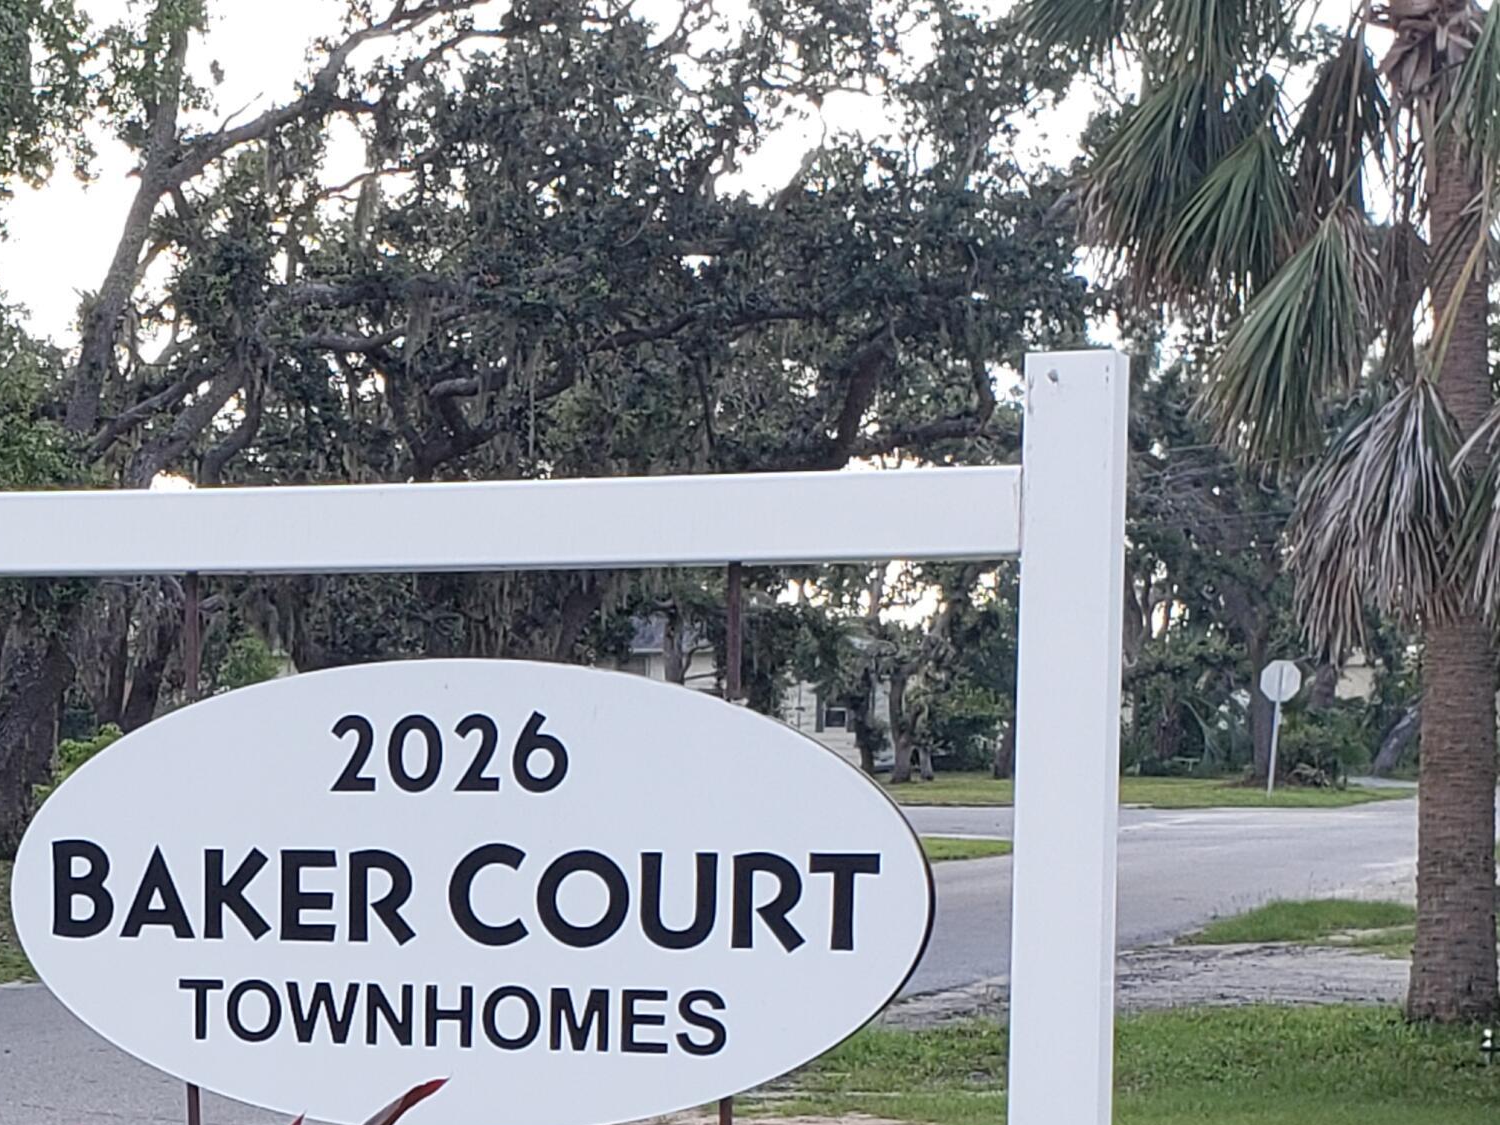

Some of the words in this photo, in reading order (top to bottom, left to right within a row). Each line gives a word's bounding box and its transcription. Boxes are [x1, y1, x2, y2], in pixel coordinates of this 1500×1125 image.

[329, 709, 570, 794] 2026
[50, 838, 418, 947] BAKER
[447, 842, 882, 953] COURT
[177, 977, 728, 1057] TOWNHOMES
